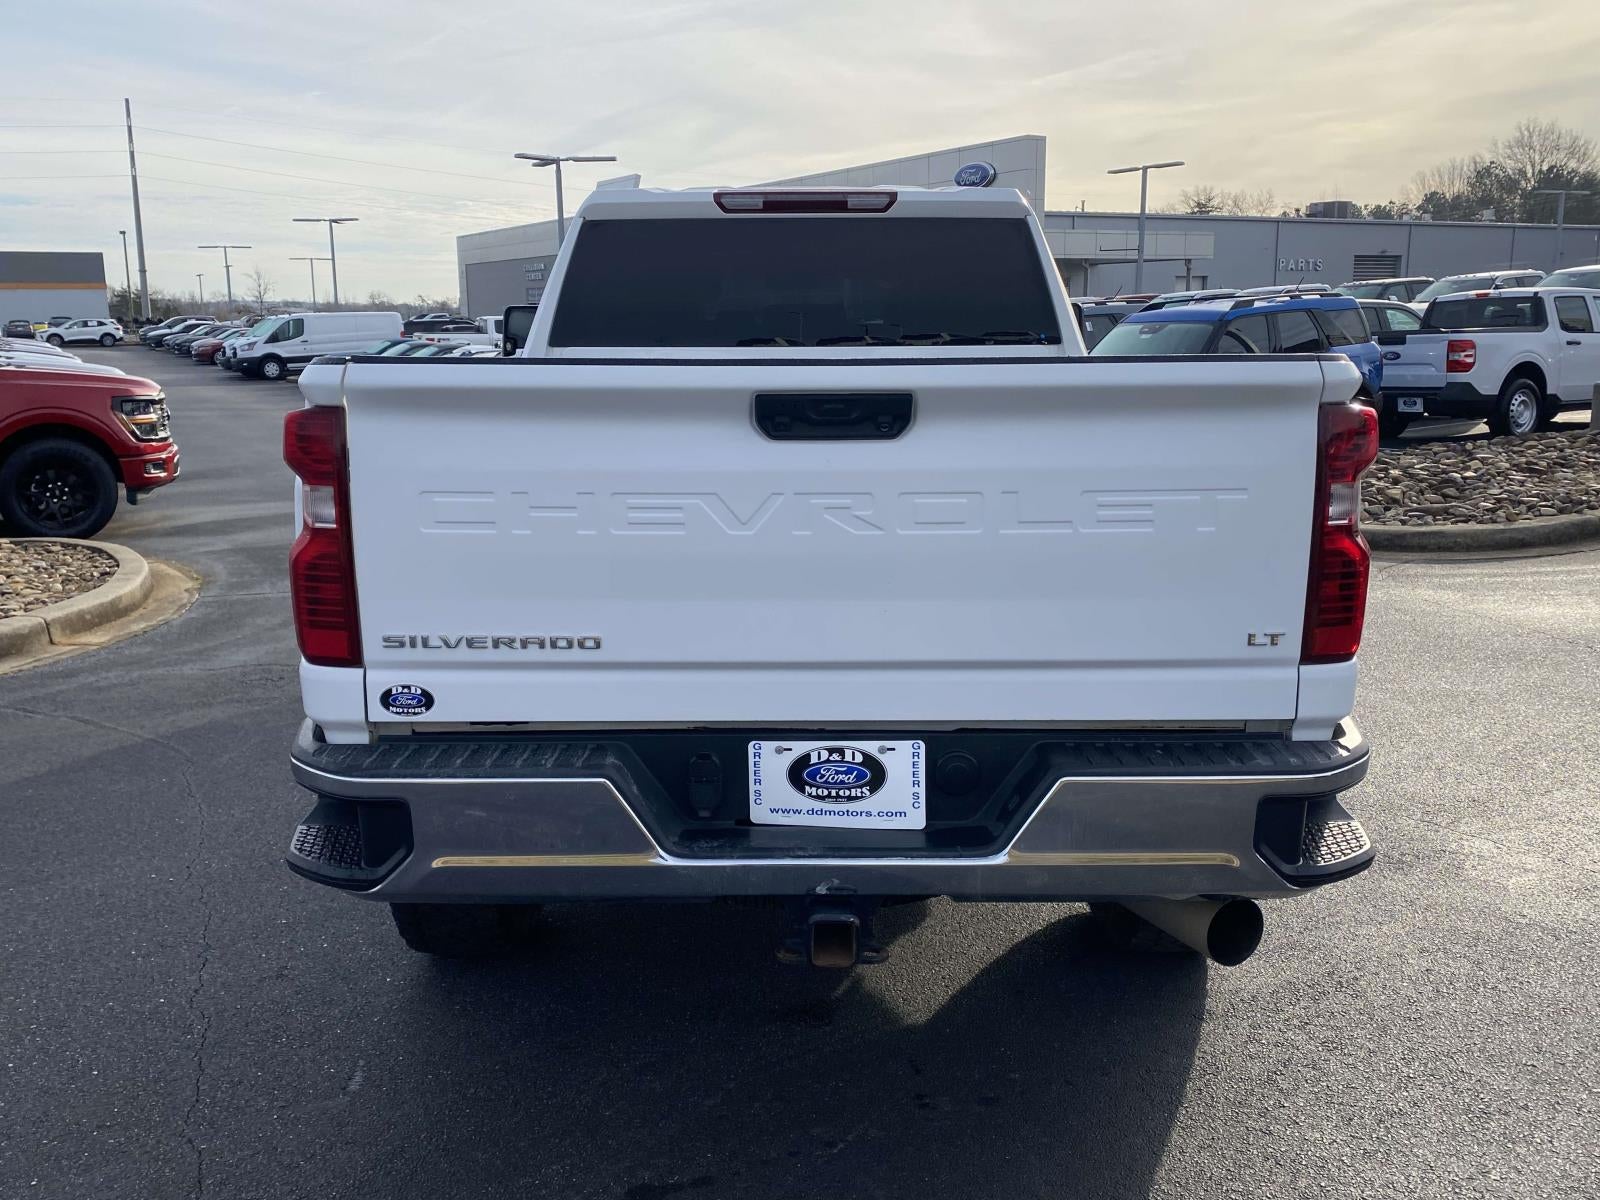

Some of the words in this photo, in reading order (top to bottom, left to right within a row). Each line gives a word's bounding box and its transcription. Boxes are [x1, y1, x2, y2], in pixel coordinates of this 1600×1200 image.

[960, 168, 982, 186] Ford
[1279, 258, 1323, 271] PARTS
[419, 488, 1249, 536] CHEVROLET
[382, 634, 602, 650] SILVERADO
[1247, 632, 1286, 647] LT
[391, 686, 422, 695] D&D
[396, 695, 418, 705] Ford
[753, 742, 762, 786] GREER
[809, 748, 864, 765] D&D
[911, 741, 921, 788] GREER
[816, 766, 858, 783] Ford
[754, 789, 763, 806] SC
[804, 785, 871, 797] MOTORS
[912, 791, 921, 810] SC
[769, 806, 907, 818] www.ddmotors.com
